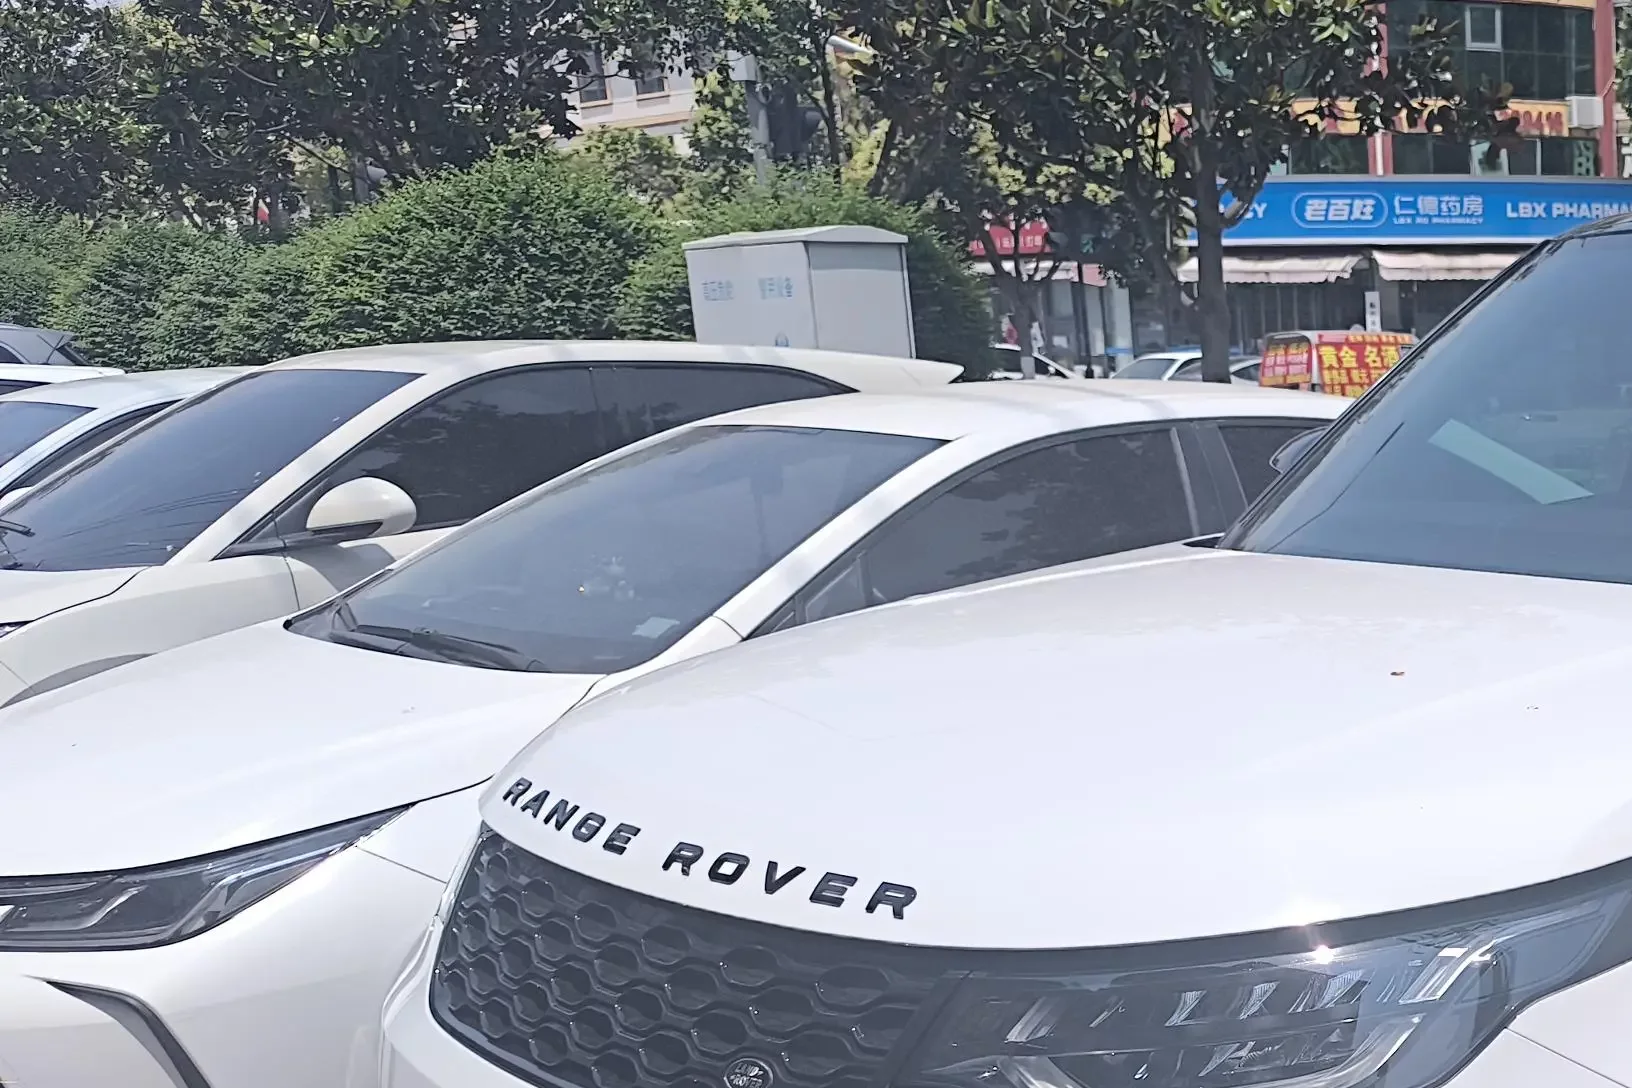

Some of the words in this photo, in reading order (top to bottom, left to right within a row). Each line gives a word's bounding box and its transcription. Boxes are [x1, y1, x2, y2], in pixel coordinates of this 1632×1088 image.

[1507, 202, 1547, 218] LBX
[502, 777, 641, 856] RANGE
[662, 841, 918, 920] ROVER
